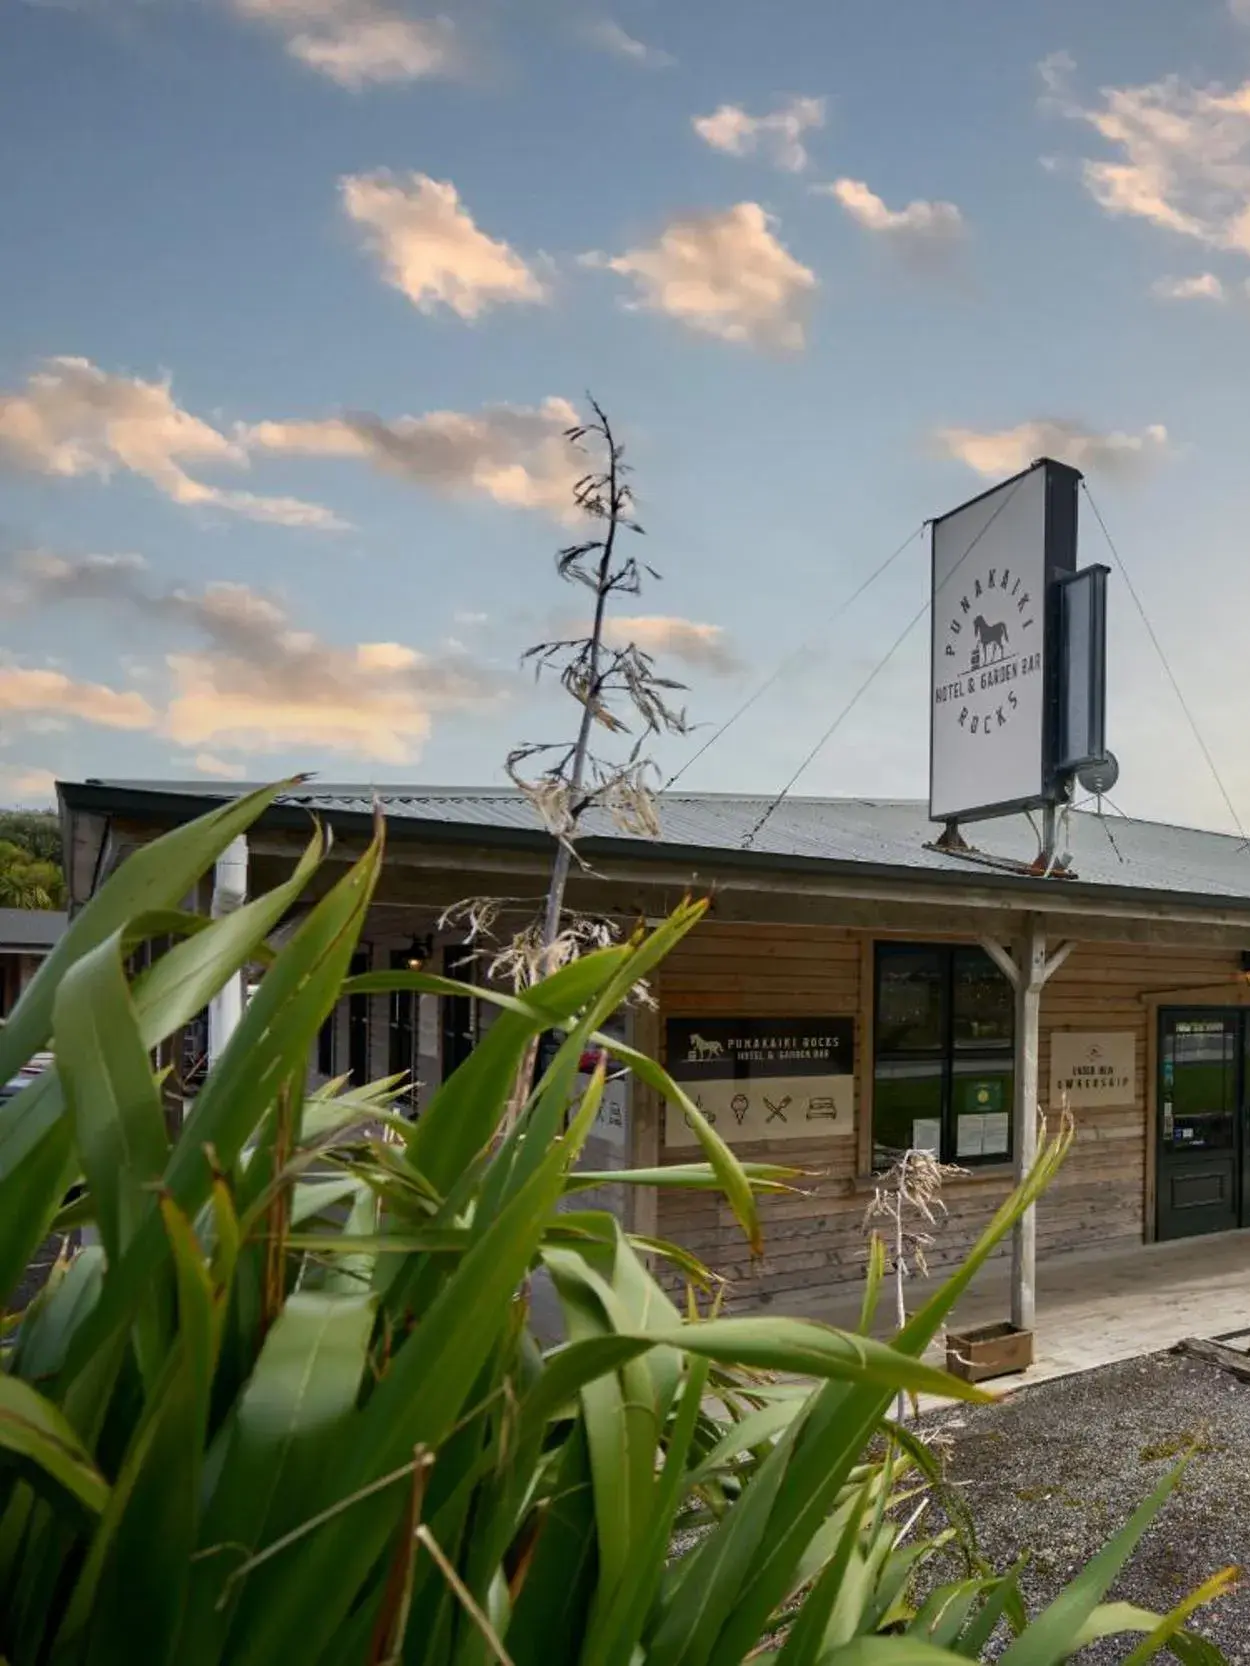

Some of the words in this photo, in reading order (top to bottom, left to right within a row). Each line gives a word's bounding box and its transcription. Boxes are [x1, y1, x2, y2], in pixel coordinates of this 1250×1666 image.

[945, 568, 1034, 656] PUNAKAIKI
[936, 680, 965, 703] HOTEL
[967, 677, 976, 694] &
[980, 662, 1018, 690] GARDEN
[1021, 653, 1041, 675] BAR
[958, 690, 1018, 735] ROCKS
[728, 1037, 798, 1049] PUNAKAIKI
[801, 1036, 840, 1048] ROCKS
